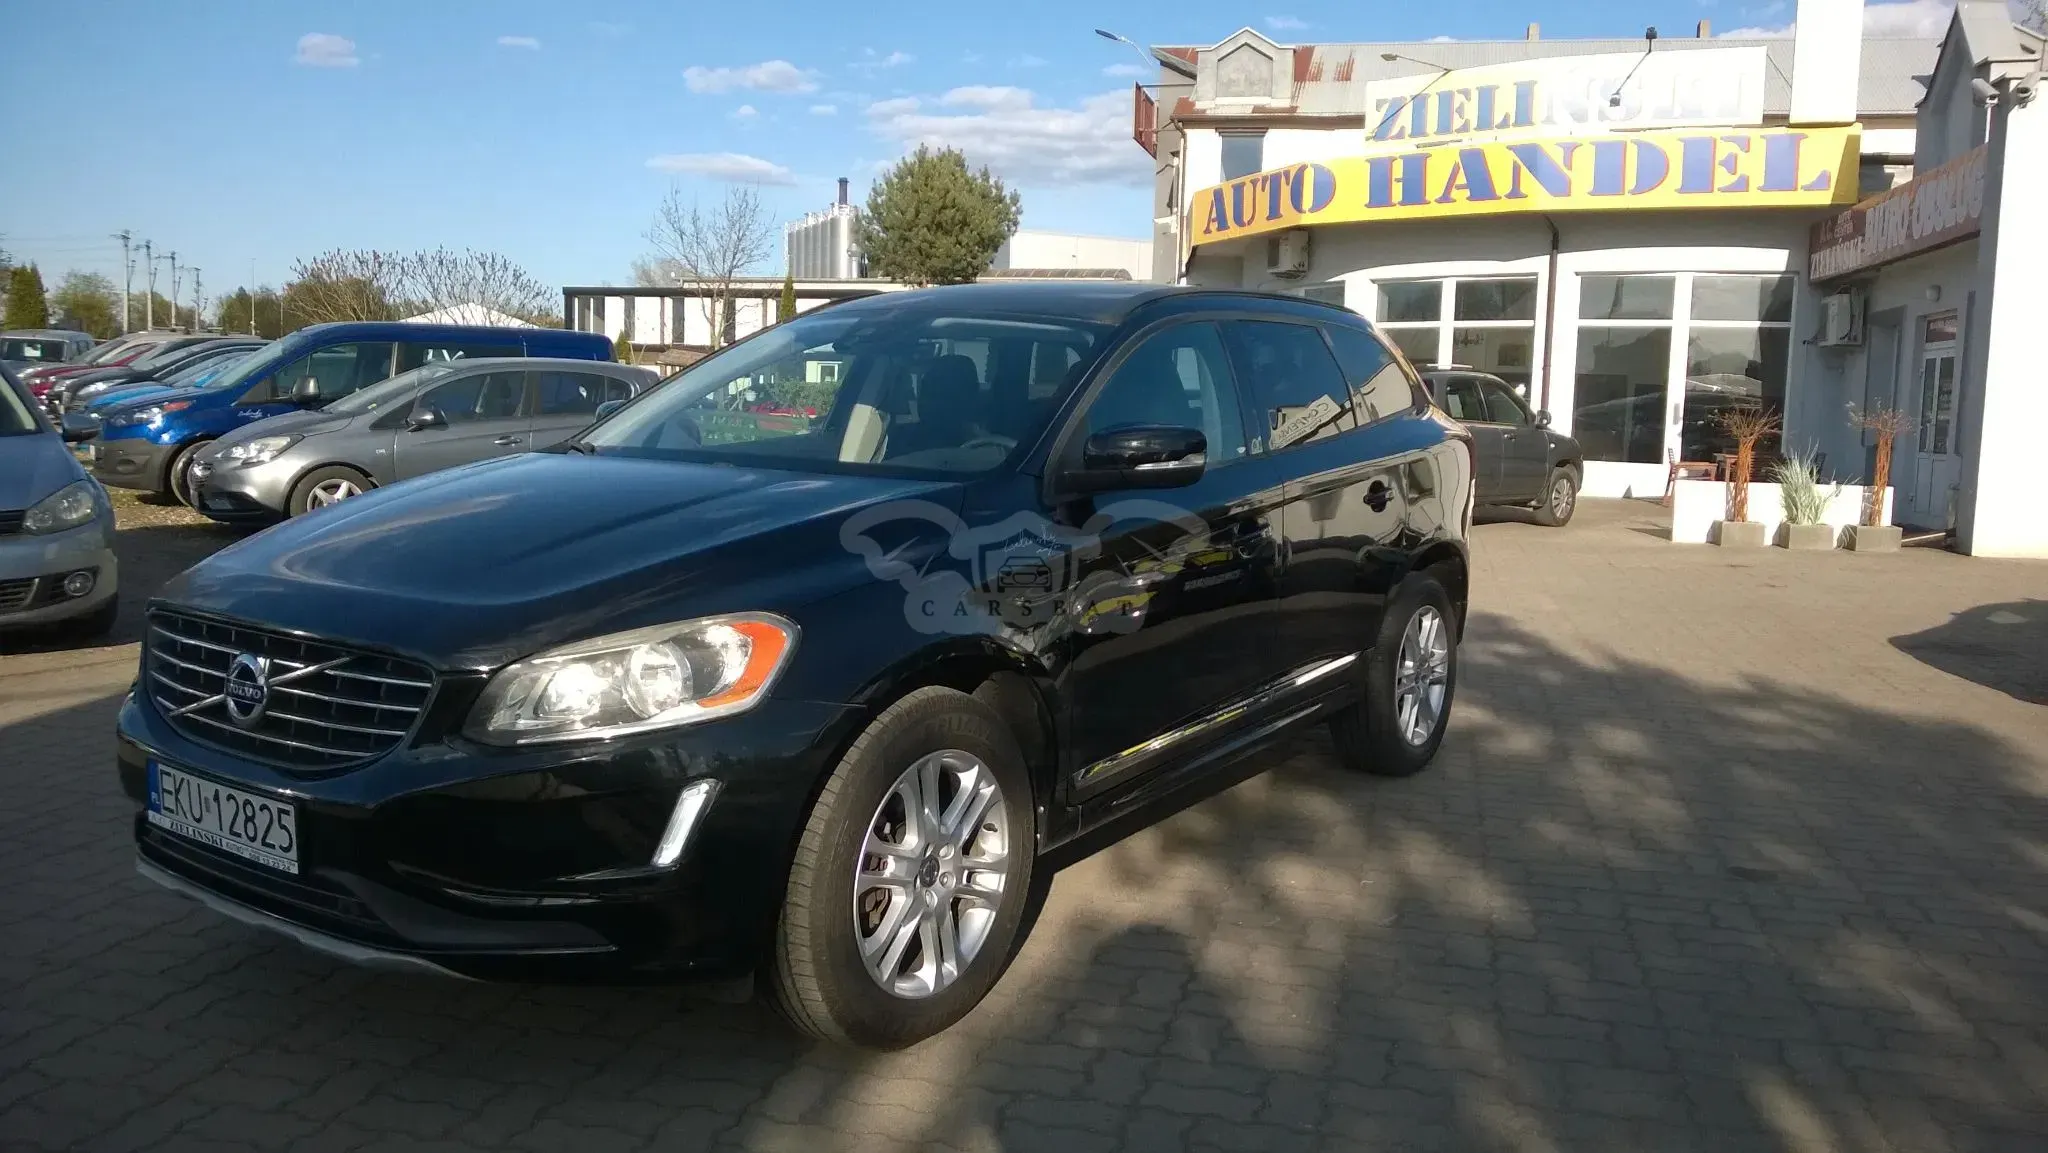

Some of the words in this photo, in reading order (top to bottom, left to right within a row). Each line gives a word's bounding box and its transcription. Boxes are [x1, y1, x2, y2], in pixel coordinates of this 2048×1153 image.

[1202, 163, 1337, 236] AUTO
[1364, 132, 1832, 209] HANDEL
[228, 682, 262, 699] VOLVO
[159, 769, 204, 823] EKU
[212, 788, 294, 854] 12825
